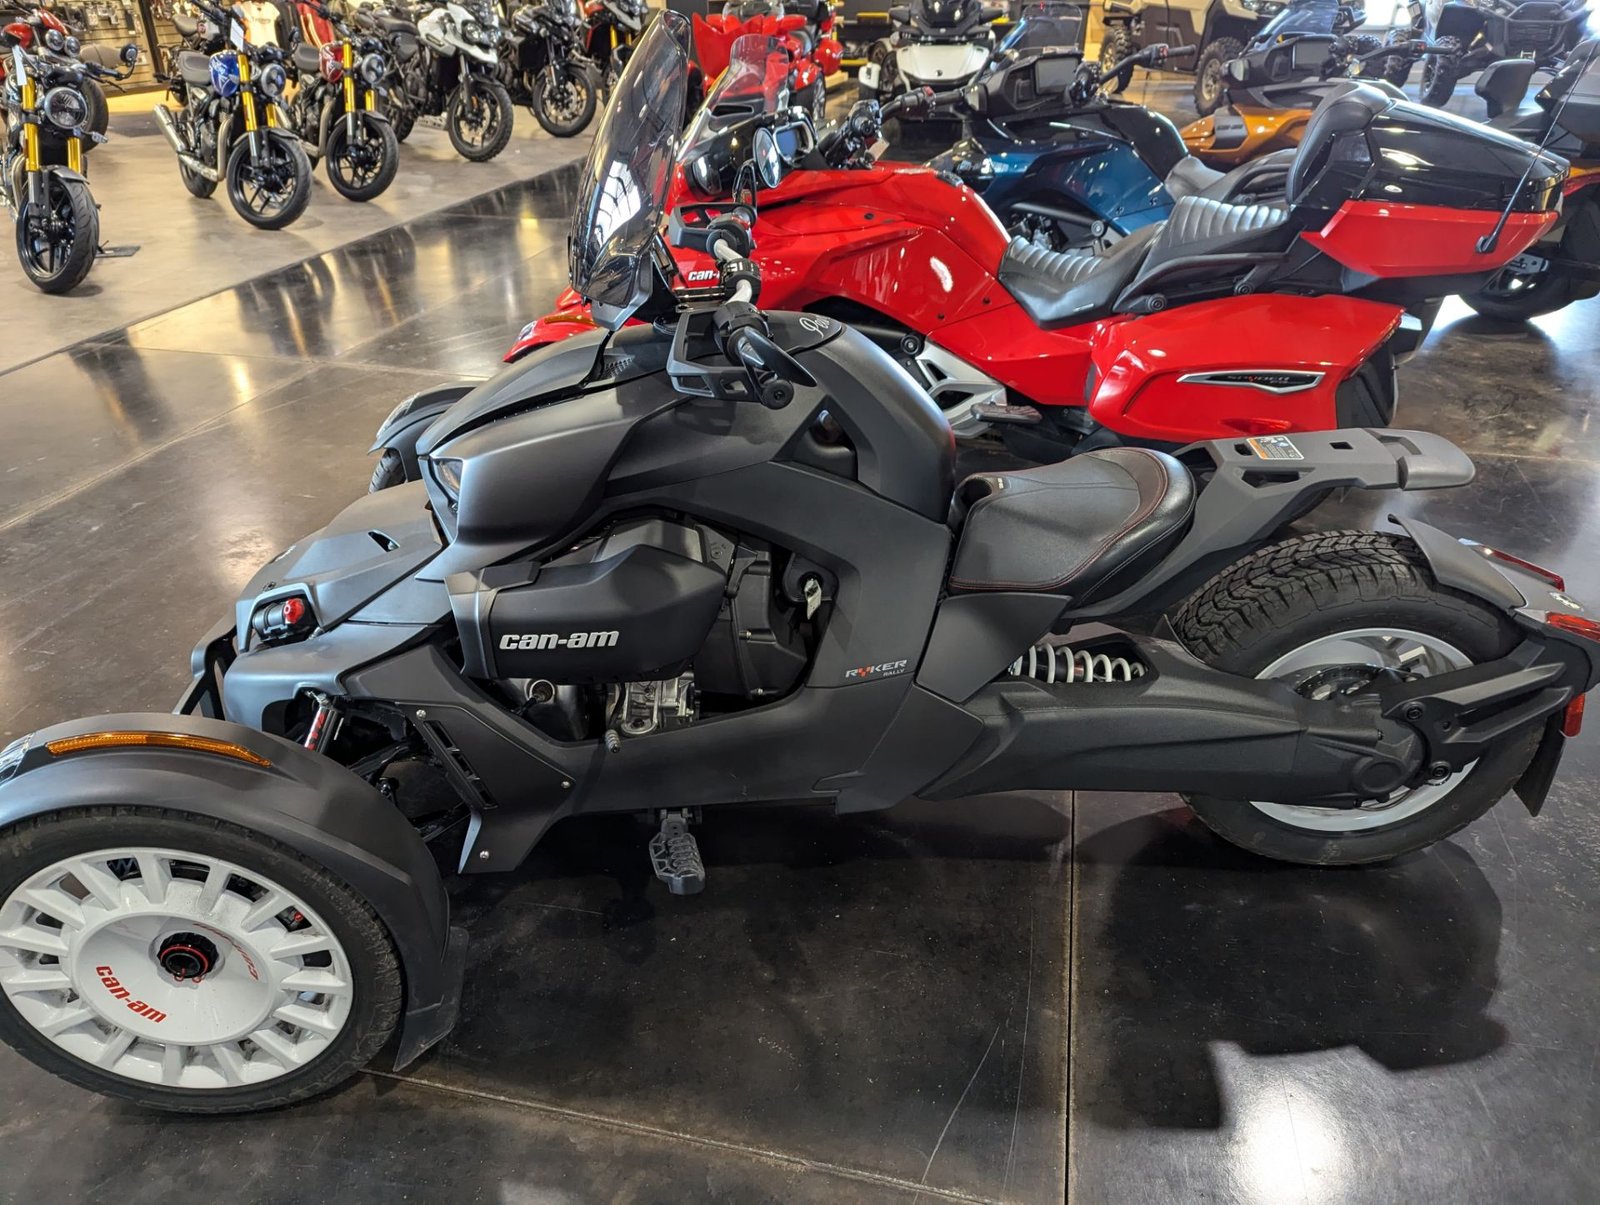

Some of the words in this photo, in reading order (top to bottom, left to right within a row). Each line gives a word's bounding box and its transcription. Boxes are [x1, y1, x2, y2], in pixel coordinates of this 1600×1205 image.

[499, 630, 619, 650] can-am
[845, 659, 907, 678] RYKER
[883, 668, 904, 677] RALLY
[95, 965, 167, 1023] can-am
